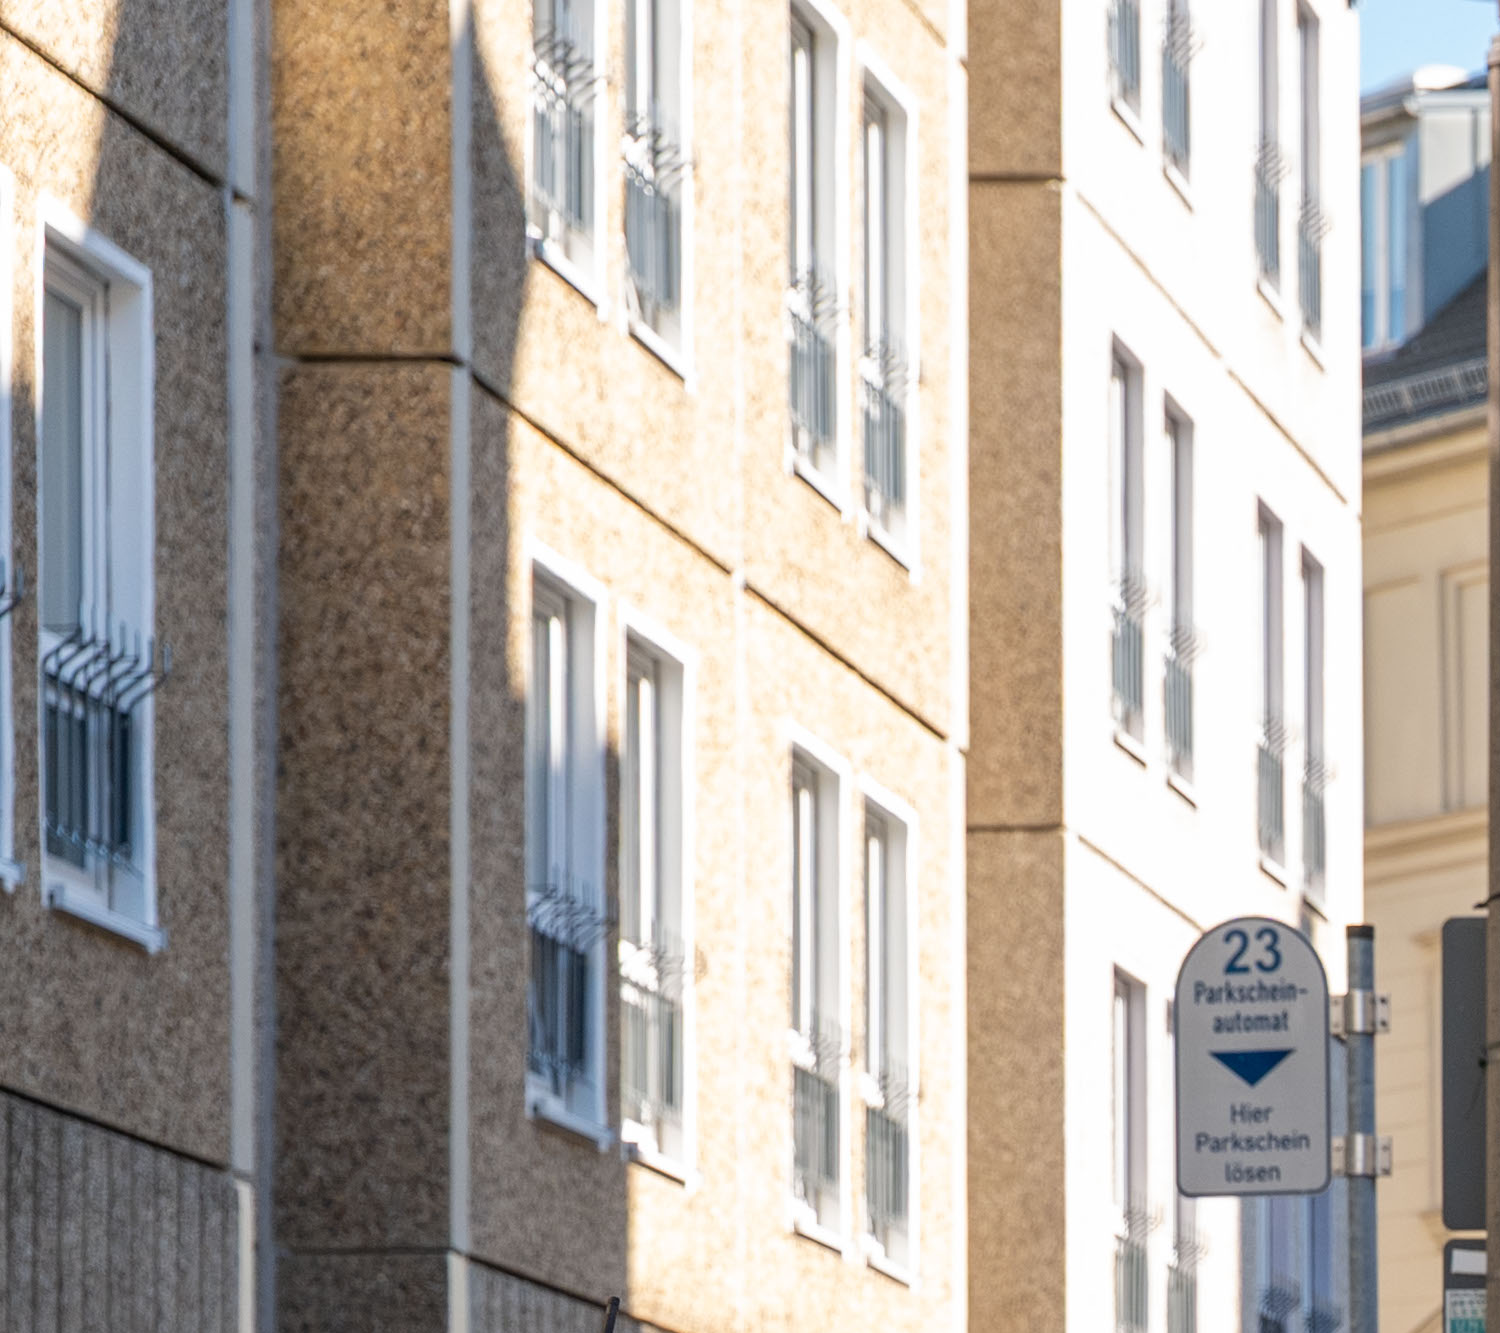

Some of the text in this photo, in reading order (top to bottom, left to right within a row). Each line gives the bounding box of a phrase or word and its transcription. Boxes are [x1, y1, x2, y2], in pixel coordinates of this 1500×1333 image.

[1224, 927, 1282, 974] 23
[1193, 978, 1308, 1005] Parkschein-
[1213, 1009, 1289, 1033] automat
[1229, 1103, 1273, 1123] Hier
[1195, 1130, 1311, 1153] Parkschein
[1225, 1160, 1281, 1183] lösen
